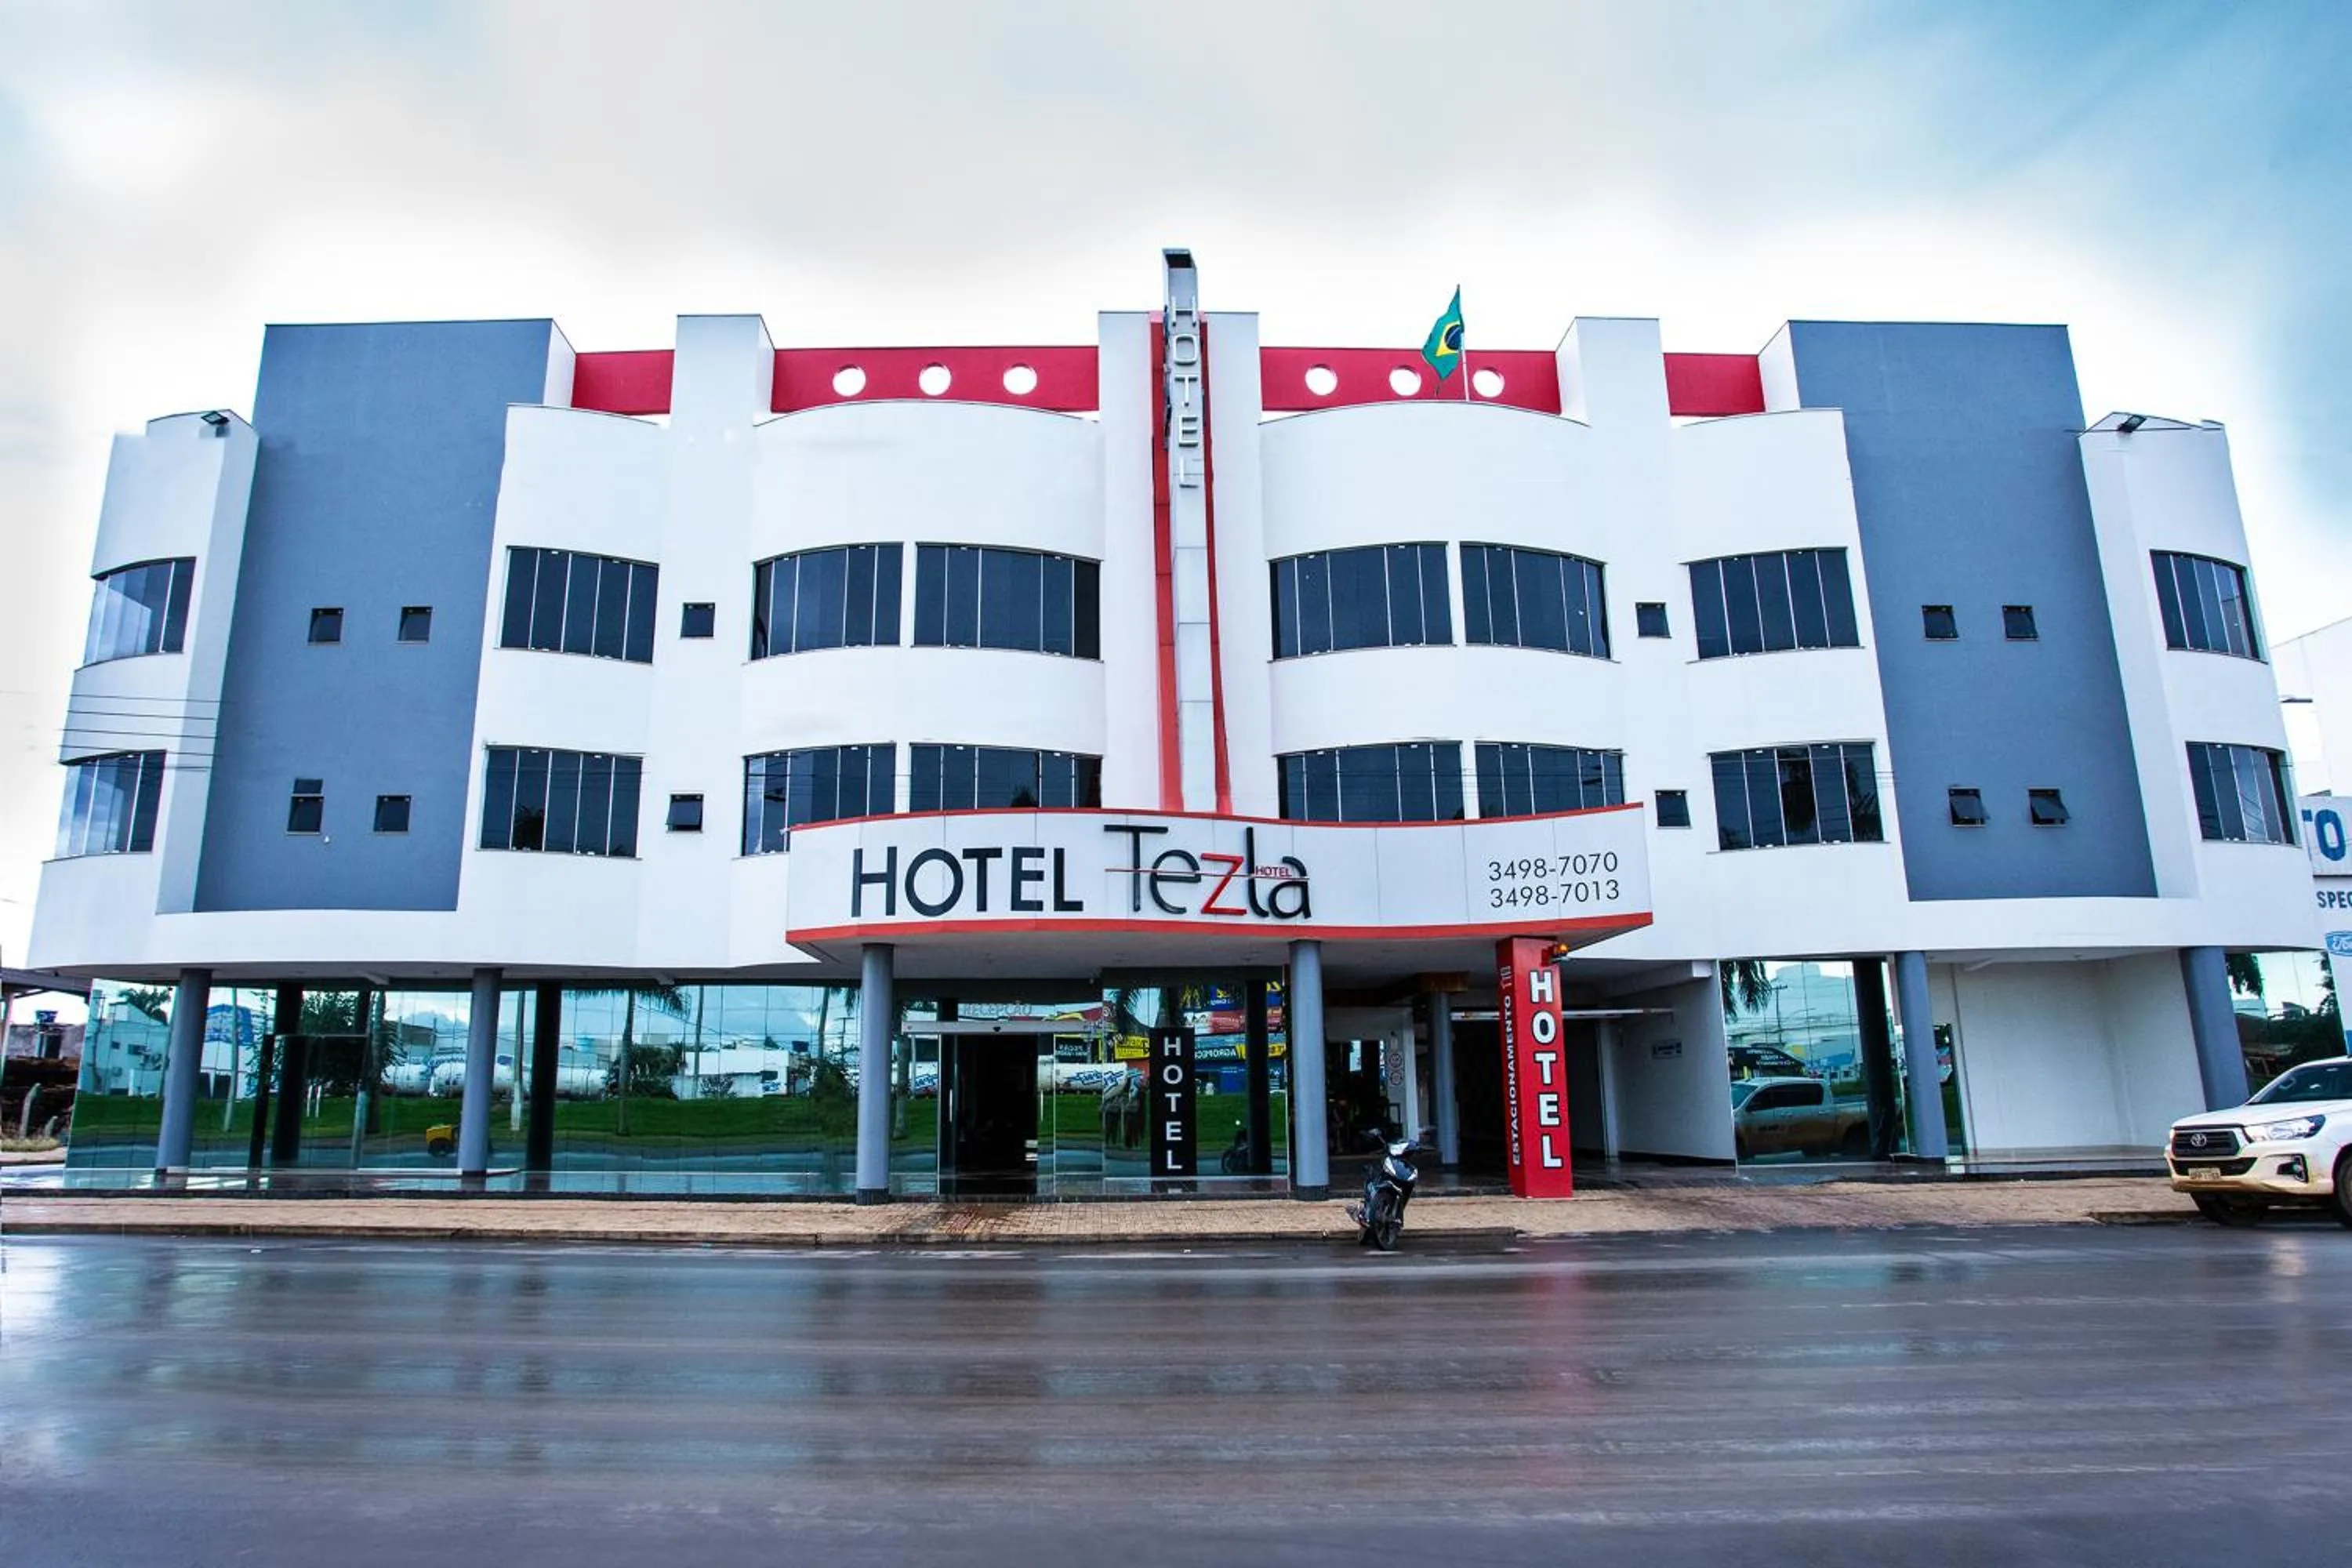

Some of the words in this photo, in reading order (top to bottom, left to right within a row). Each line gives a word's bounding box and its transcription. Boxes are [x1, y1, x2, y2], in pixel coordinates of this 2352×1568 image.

[1172, 295, 1200, 488] HOTEL
[851, 846, 1083, 917] HOTEL
[1104, 824, 1311, 919] Tezla
[1255, 866, 1293, 877] HOTEL
[1489, 851, 1617, 881] 3498-7070
[1490, 879, 1619, 908] 3498-7013
[1163, 1036, 1184, 1169] HOTEL
[1504, 995, 1521, 1166] ESTACIONAMENTO
[1530, 971, 1563, 1168] HOTEL
